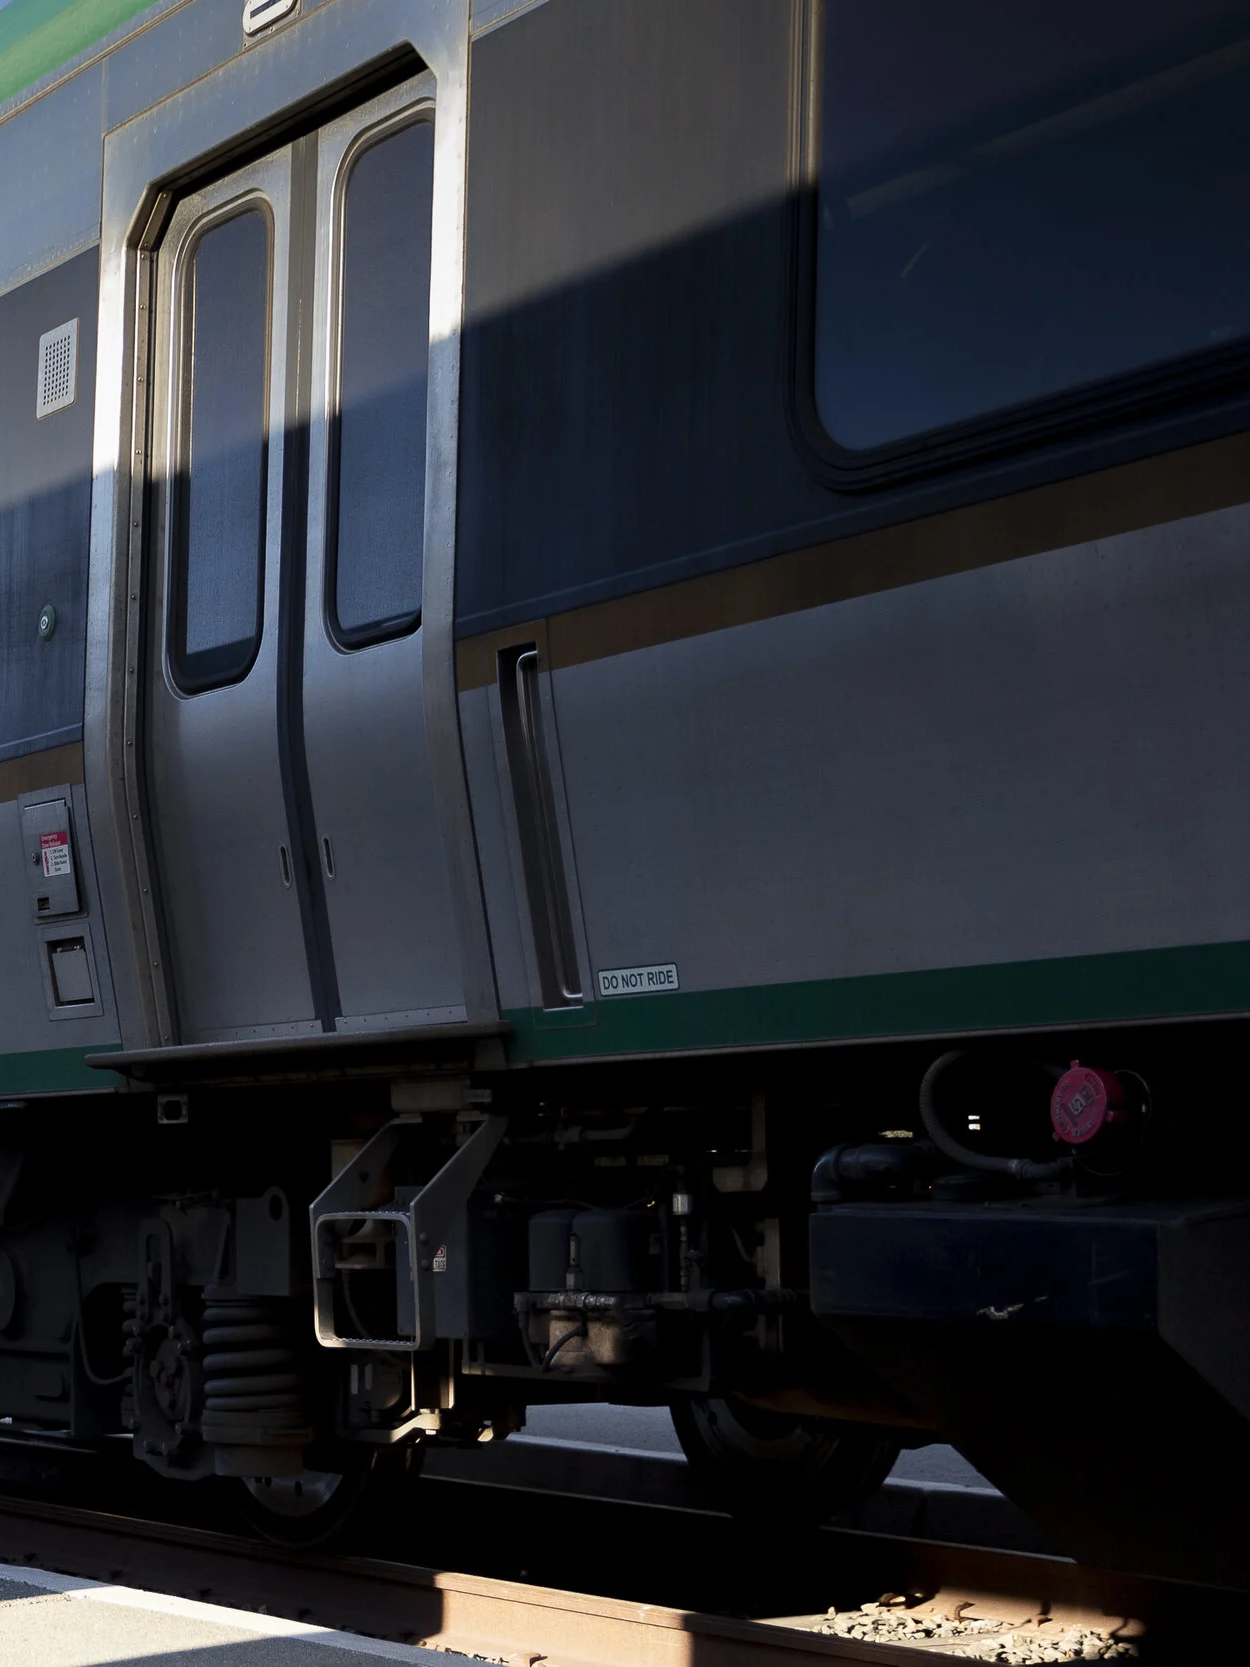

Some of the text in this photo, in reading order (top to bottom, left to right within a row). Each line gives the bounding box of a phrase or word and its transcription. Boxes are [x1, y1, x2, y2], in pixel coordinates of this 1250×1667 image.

[602, 970, 674, 990] DO NOT RIDE
